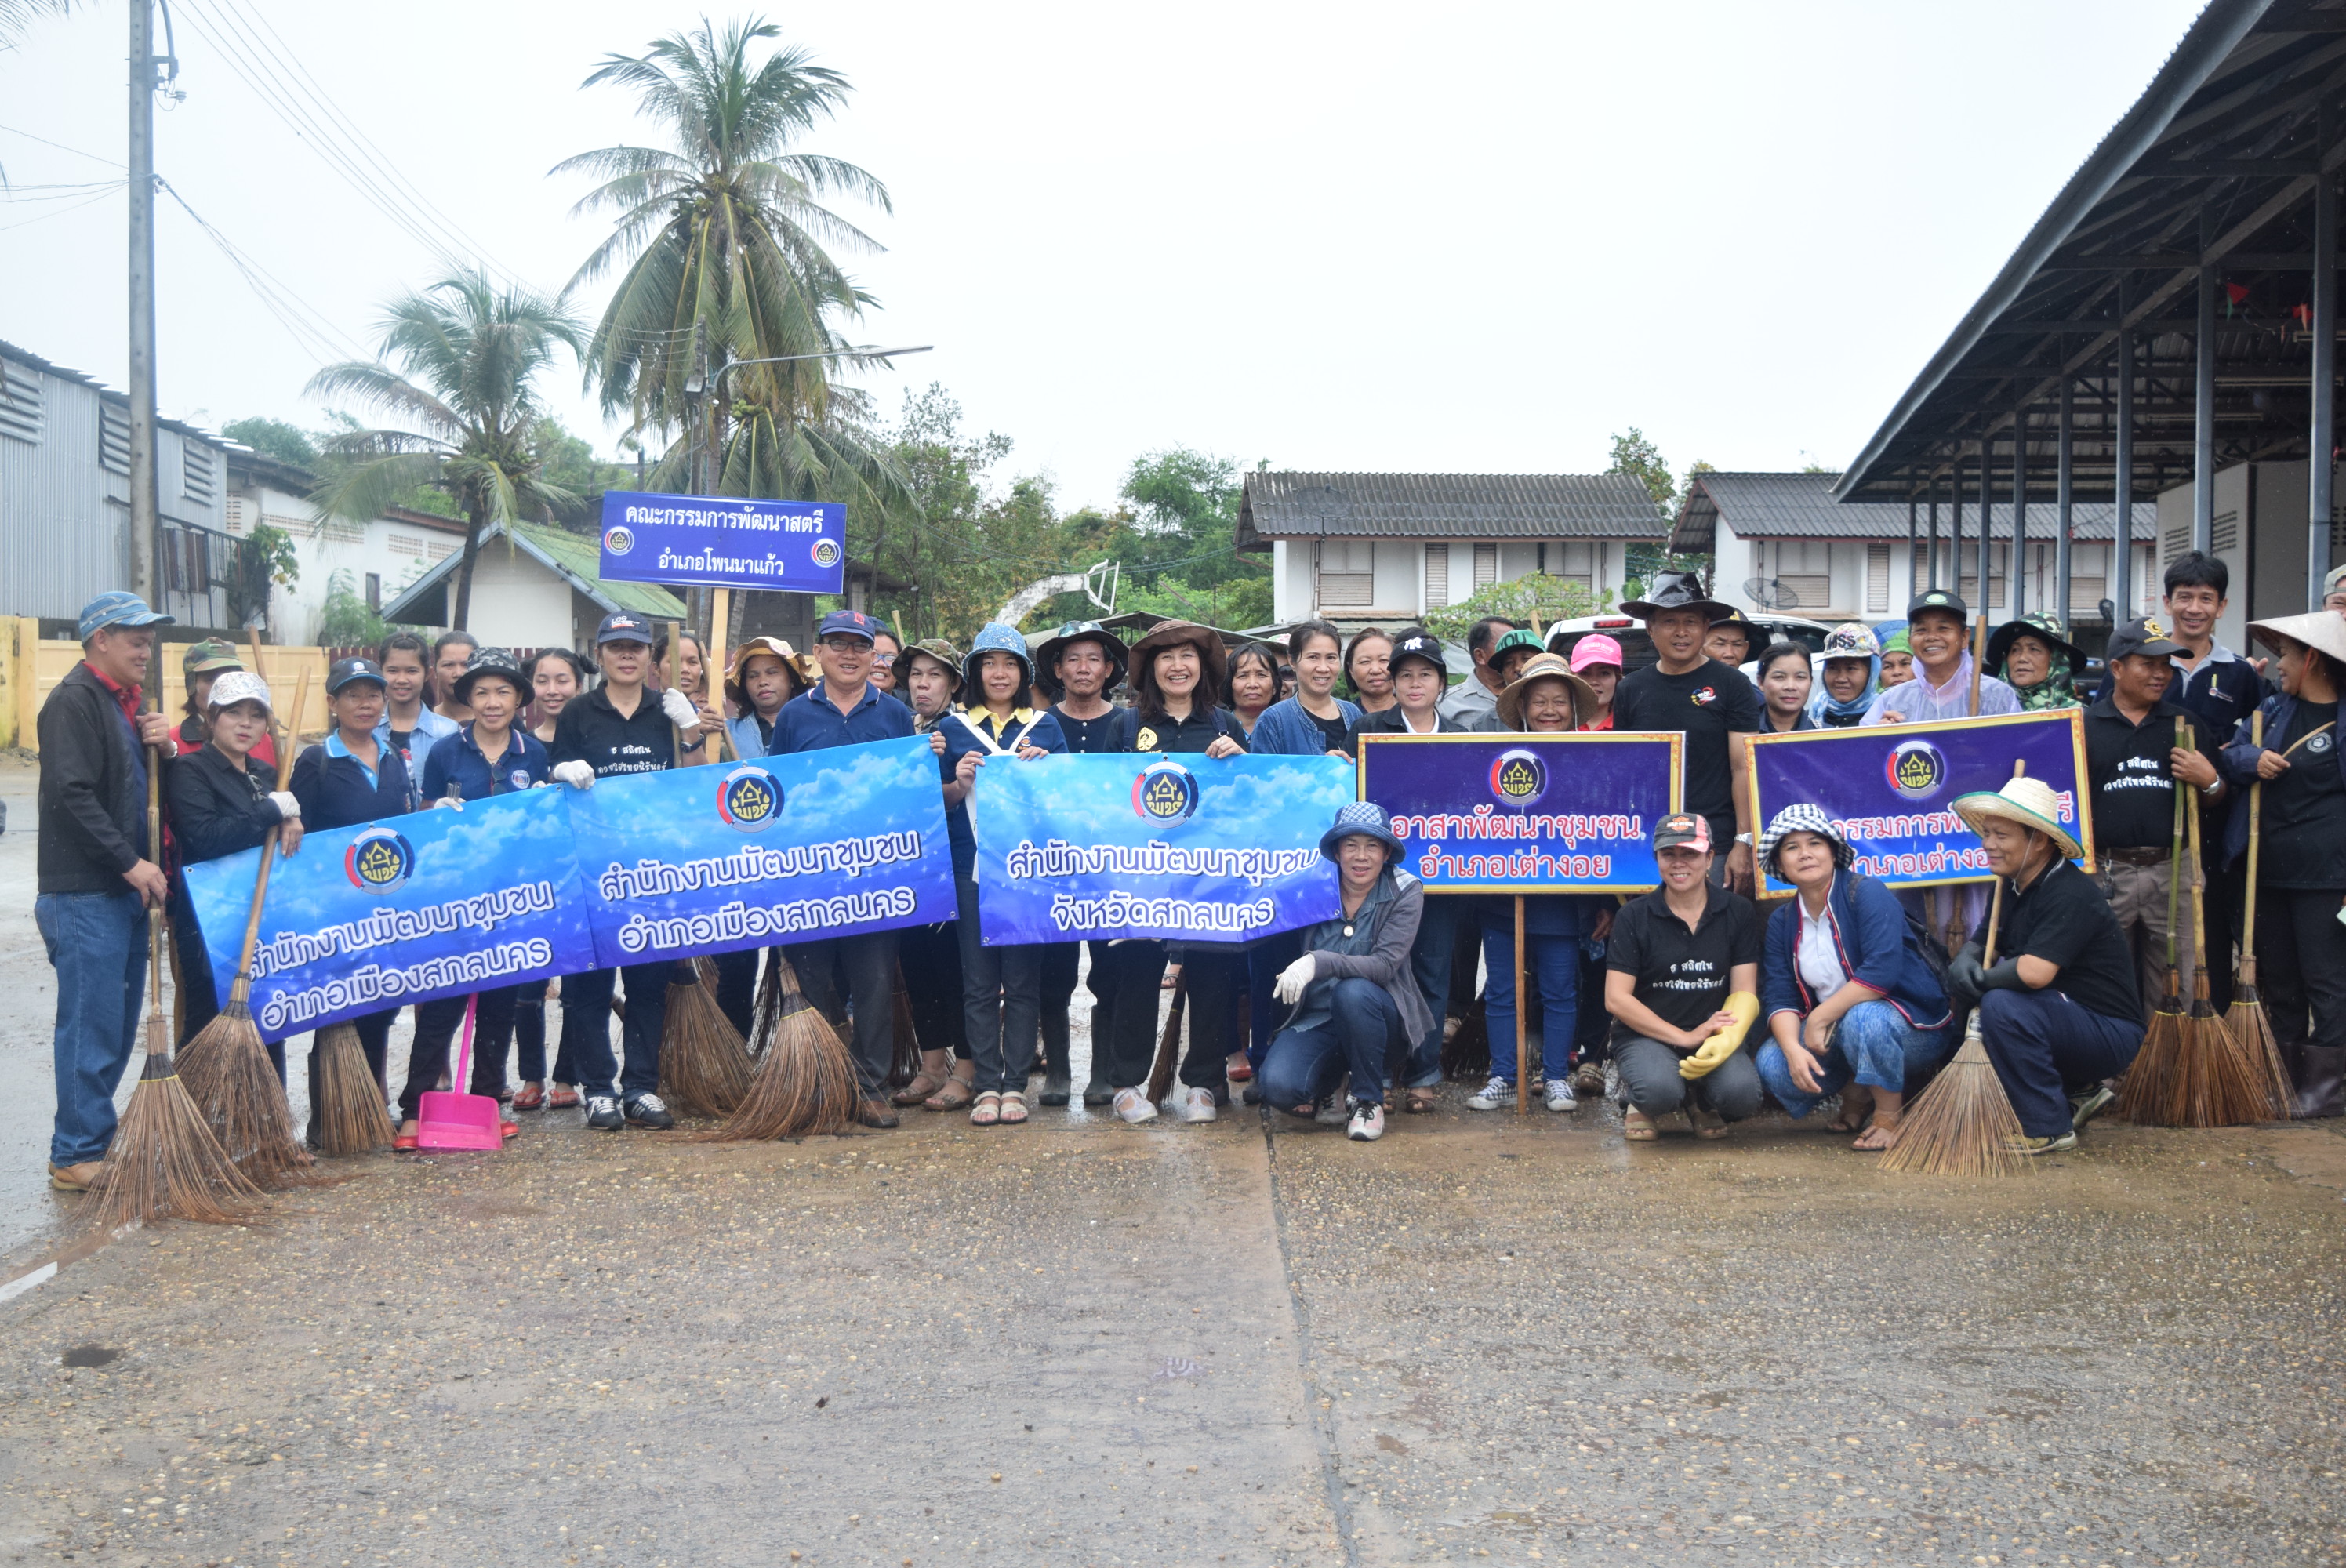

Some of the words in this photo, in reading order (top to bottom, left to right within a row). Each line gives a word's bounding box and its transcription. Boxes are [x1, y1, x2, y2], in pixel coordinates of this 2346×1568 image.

[626, 506, 824, 534] คณะกรรมการพัฒนาสตรี
[659, 546, 784, 575] อำเภอโพนนาแก้ว
[1390, 804, 1640, 849] อาสาพัฒนาชุมชน
[599, 829, 921, 902] สำนักงานพัฒนาชุมชน
[1007, 839, 1320, 887] สำนักงานพัฒนาชุมชน
[1419, 844, 1611, 878] อำเภอเต่างอย
[619, 886, 916, 953] อำเภอเมืองสกลนคร
[1051, 890, 1275, 932] จังหวัดสกลนคร
[261, 937, 553, 1031] อำเภอเมืองสกลนคร
